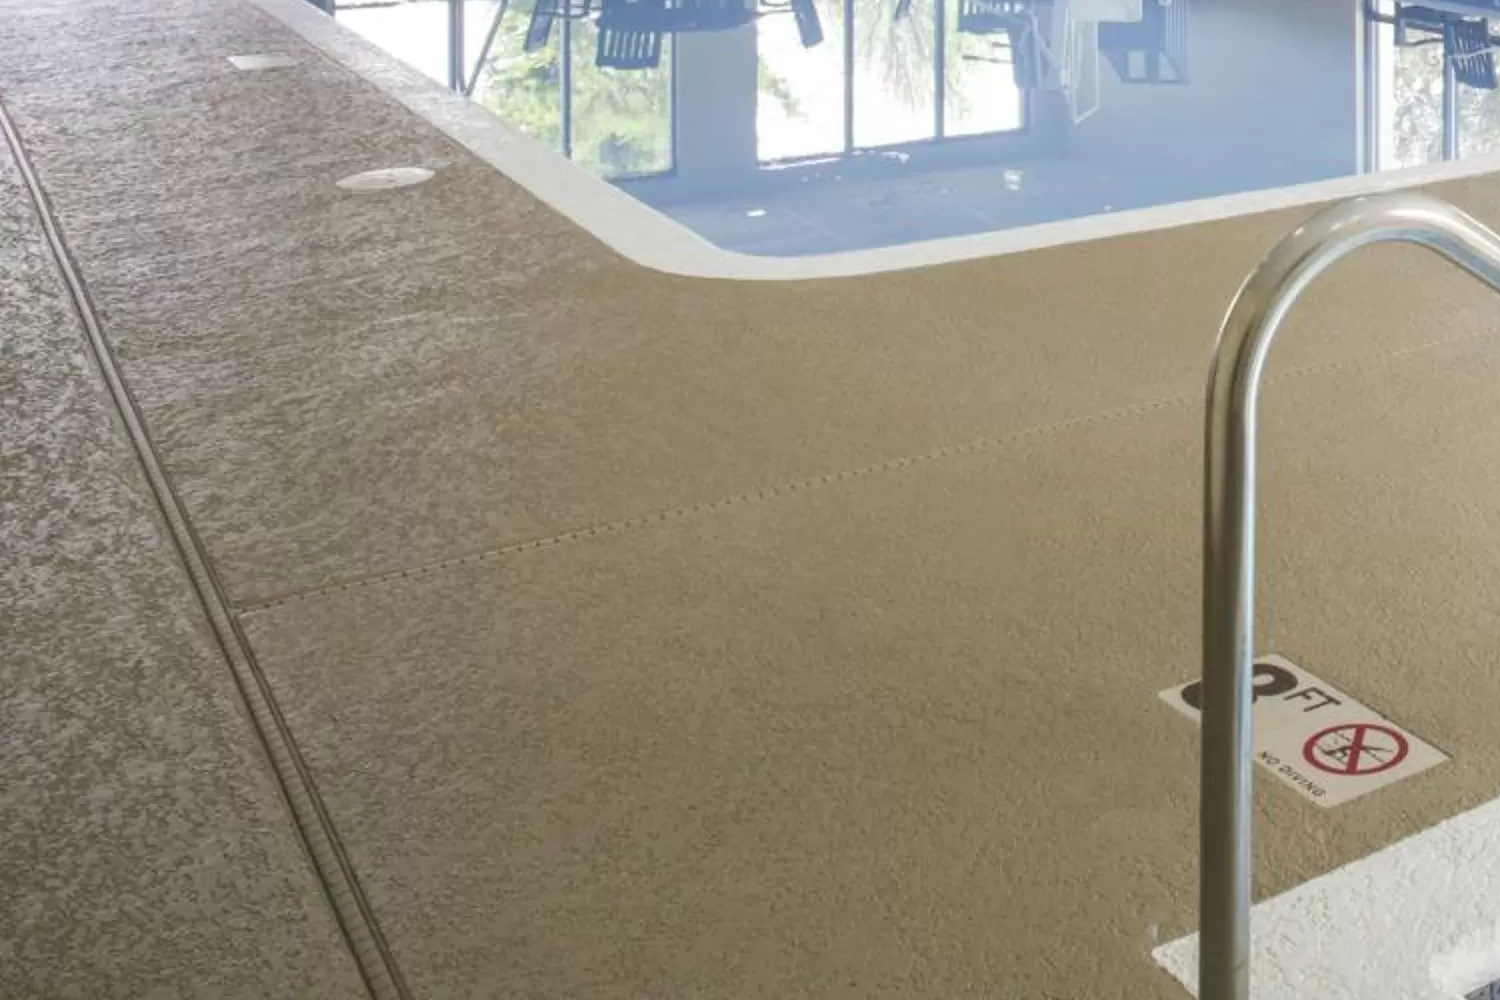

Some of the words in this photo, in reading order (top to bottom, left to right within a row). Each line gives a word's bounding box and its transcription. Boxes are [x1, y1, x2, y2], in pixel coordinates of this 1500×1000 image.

[1283, 686, 1342, 712] FT
[1259, 751, 1280, 765] NO
[1279, 764, 1326, 797] DIVING
